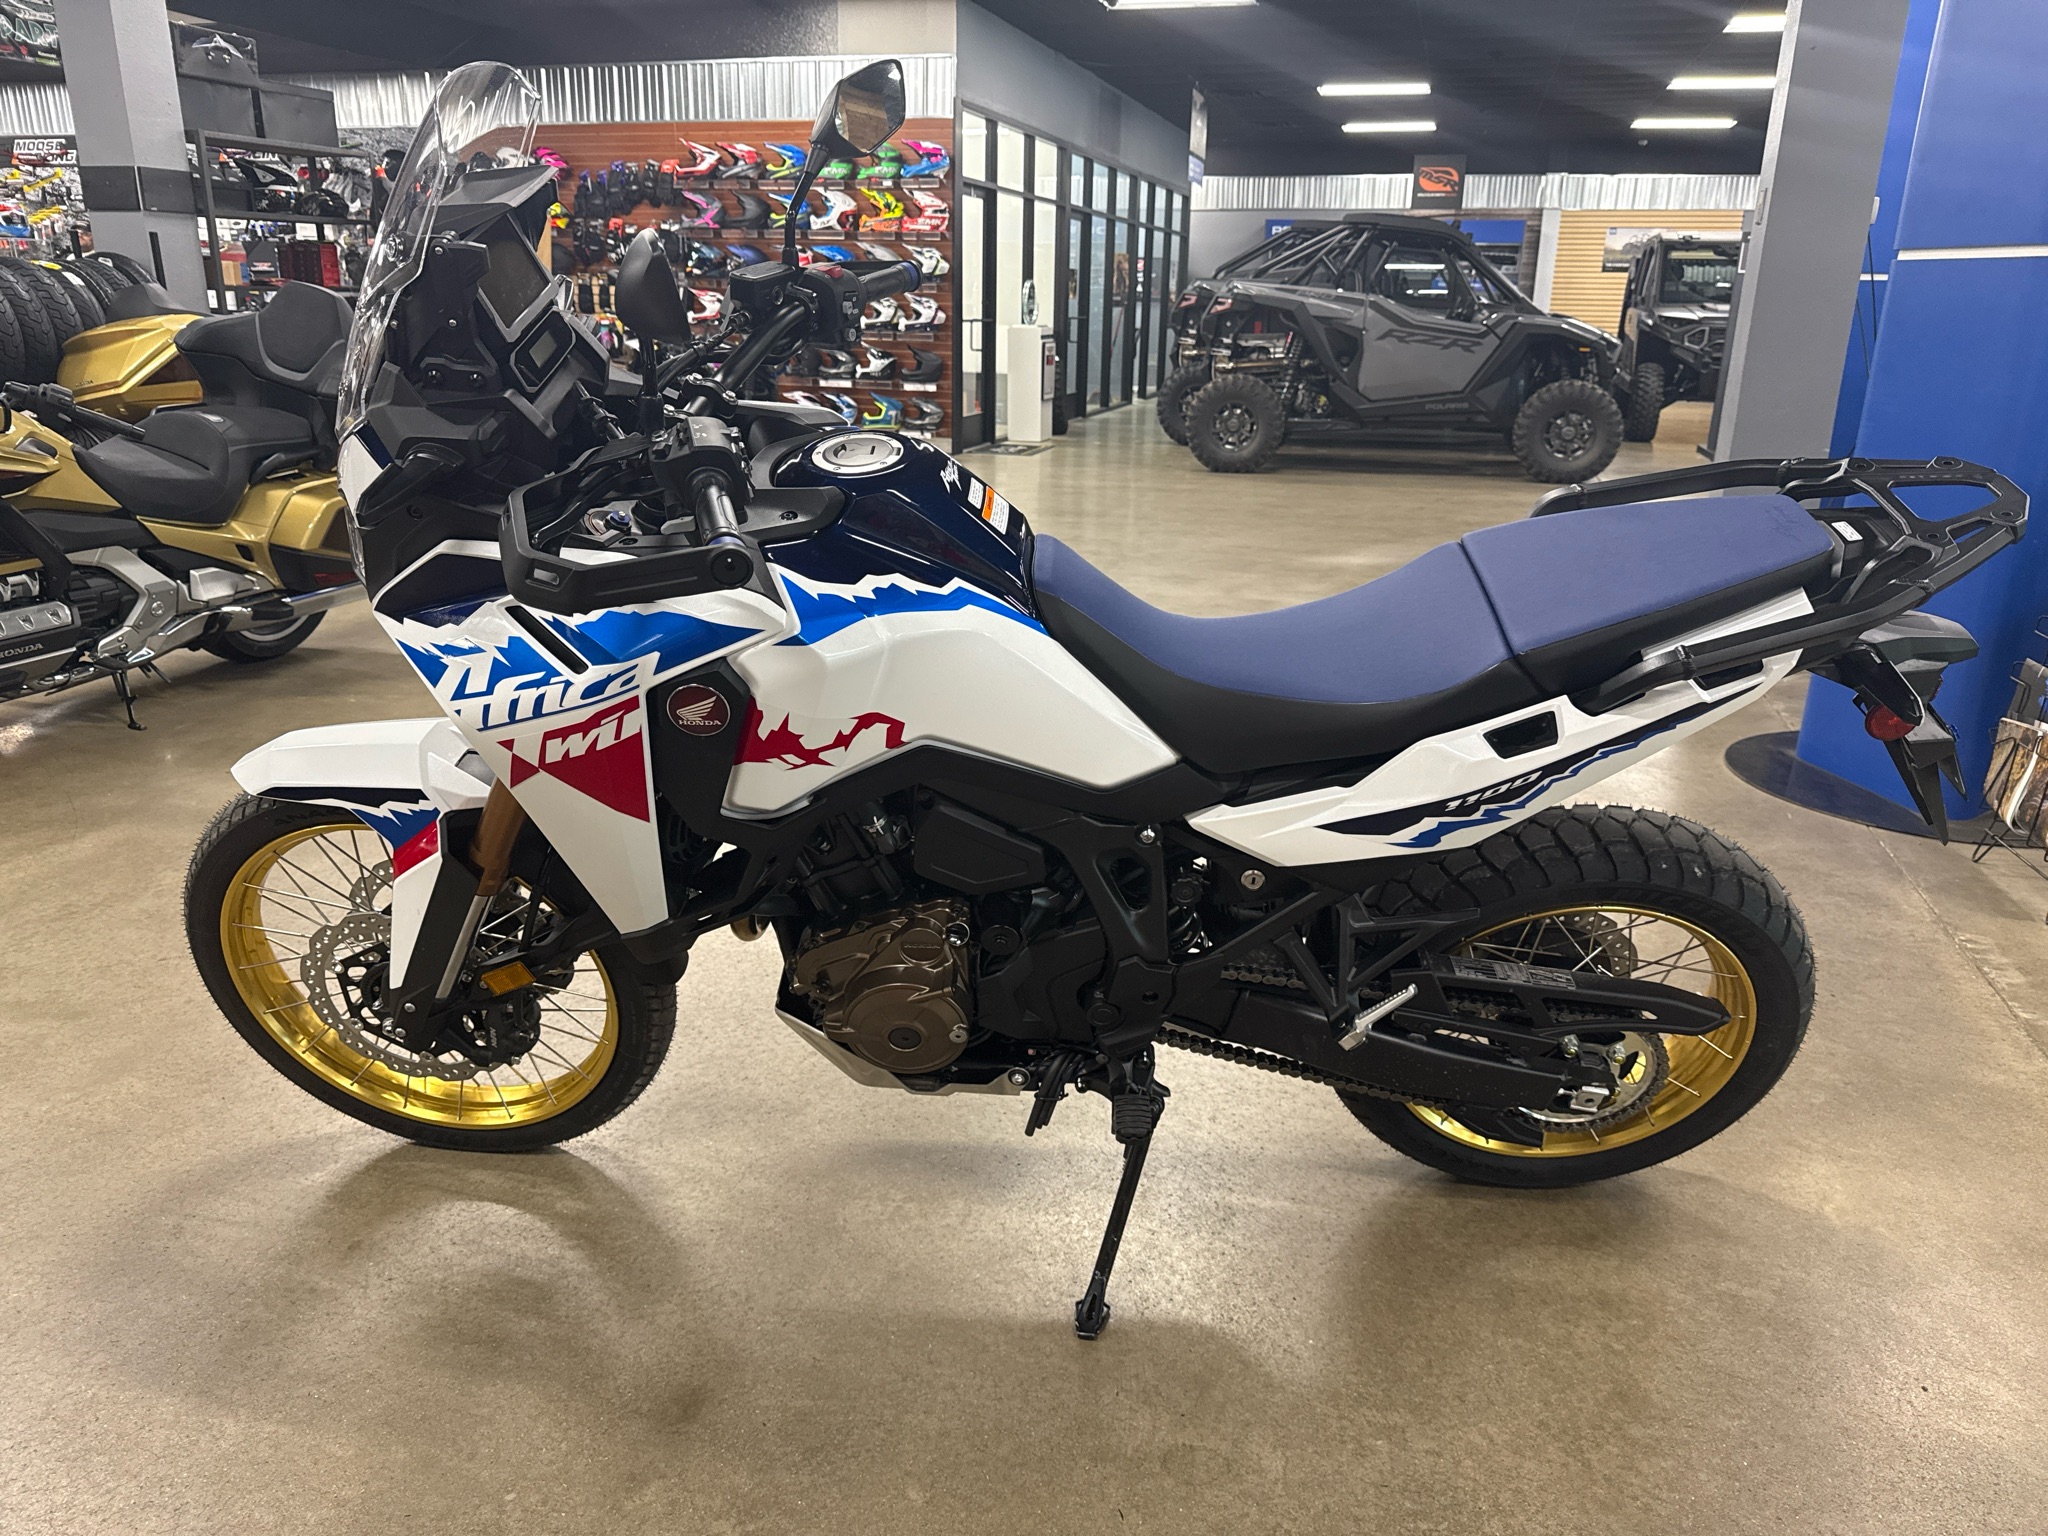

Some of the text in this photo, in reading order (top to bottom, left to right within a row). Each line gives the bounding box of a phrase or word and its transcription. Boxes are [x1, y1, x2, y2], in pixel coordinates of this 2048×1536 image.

[14, 140, 63, 151] MOOSE
[1375, 329, 1483, 353] RZR
[1424, 403, 1469, 411] POLARIS
[1444, 770, 1543, 812] 1100
